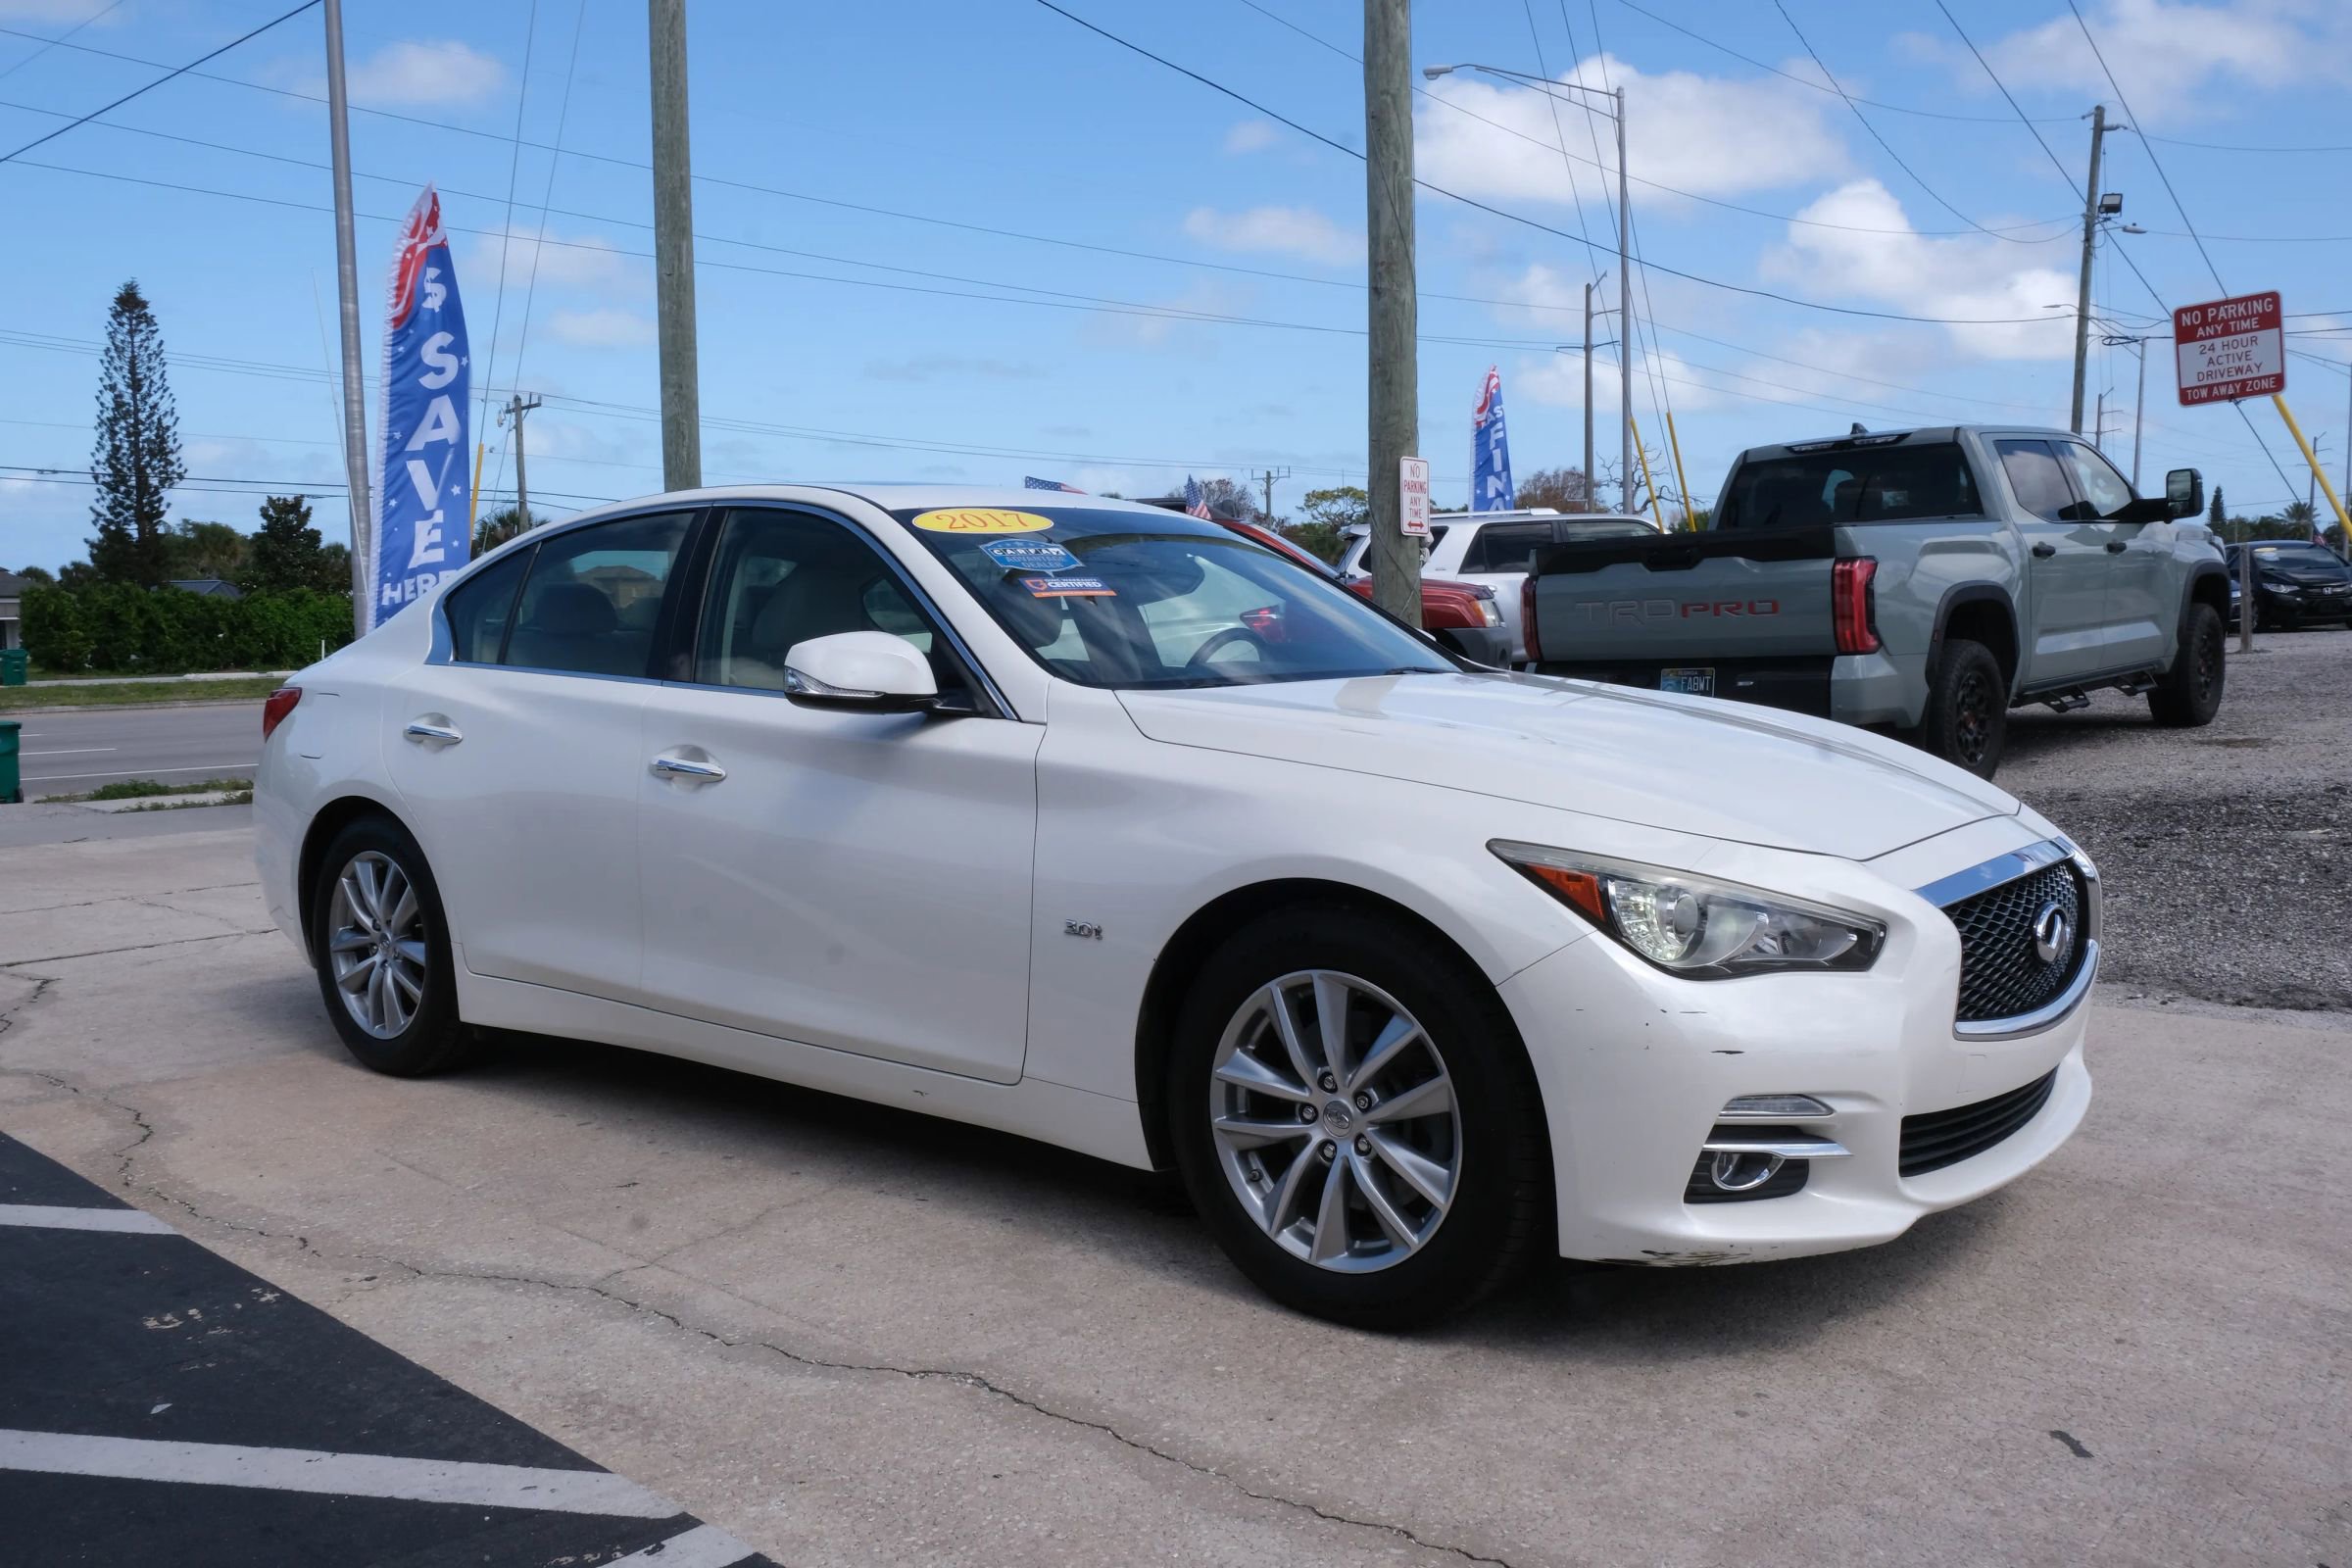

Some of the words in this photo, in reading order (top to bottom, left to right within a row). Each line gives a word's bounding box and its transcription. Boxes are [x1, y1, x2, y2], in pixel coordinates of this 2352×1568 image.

[2181, 310, 2202, 327] NO
[2207, 298, 2274, 322] PARKING
[2196, 322, 2224, 338] ANY
[2229, 317, 2260, 332] TIME
[2198, 343, 2216, 355] 24
[2221, 335, 2259, 351] HOUR
[2206, 350, 2253, 368] ACTIVE
[2196, 361, 2263, 382] DRIVEWAY
[2186, 387, 2208, 401] TOW
[2212, 381, 2242, 397] AWAY
[2245, 376, 2277, 392] ZONE
[405, 330, 462, 568] SAVE
[1409, 463, 1421, 478] NO
[1403, 479, 1427, 495] PARKING
[1409, 496, 1421, 507] ANY
[936, 513, 1030, 529] 2017
[1408, 508, 1422, 518] TIME
[1575, 600, 1676, 626] TRD
[1681, 599, 1780, 618] PRO
